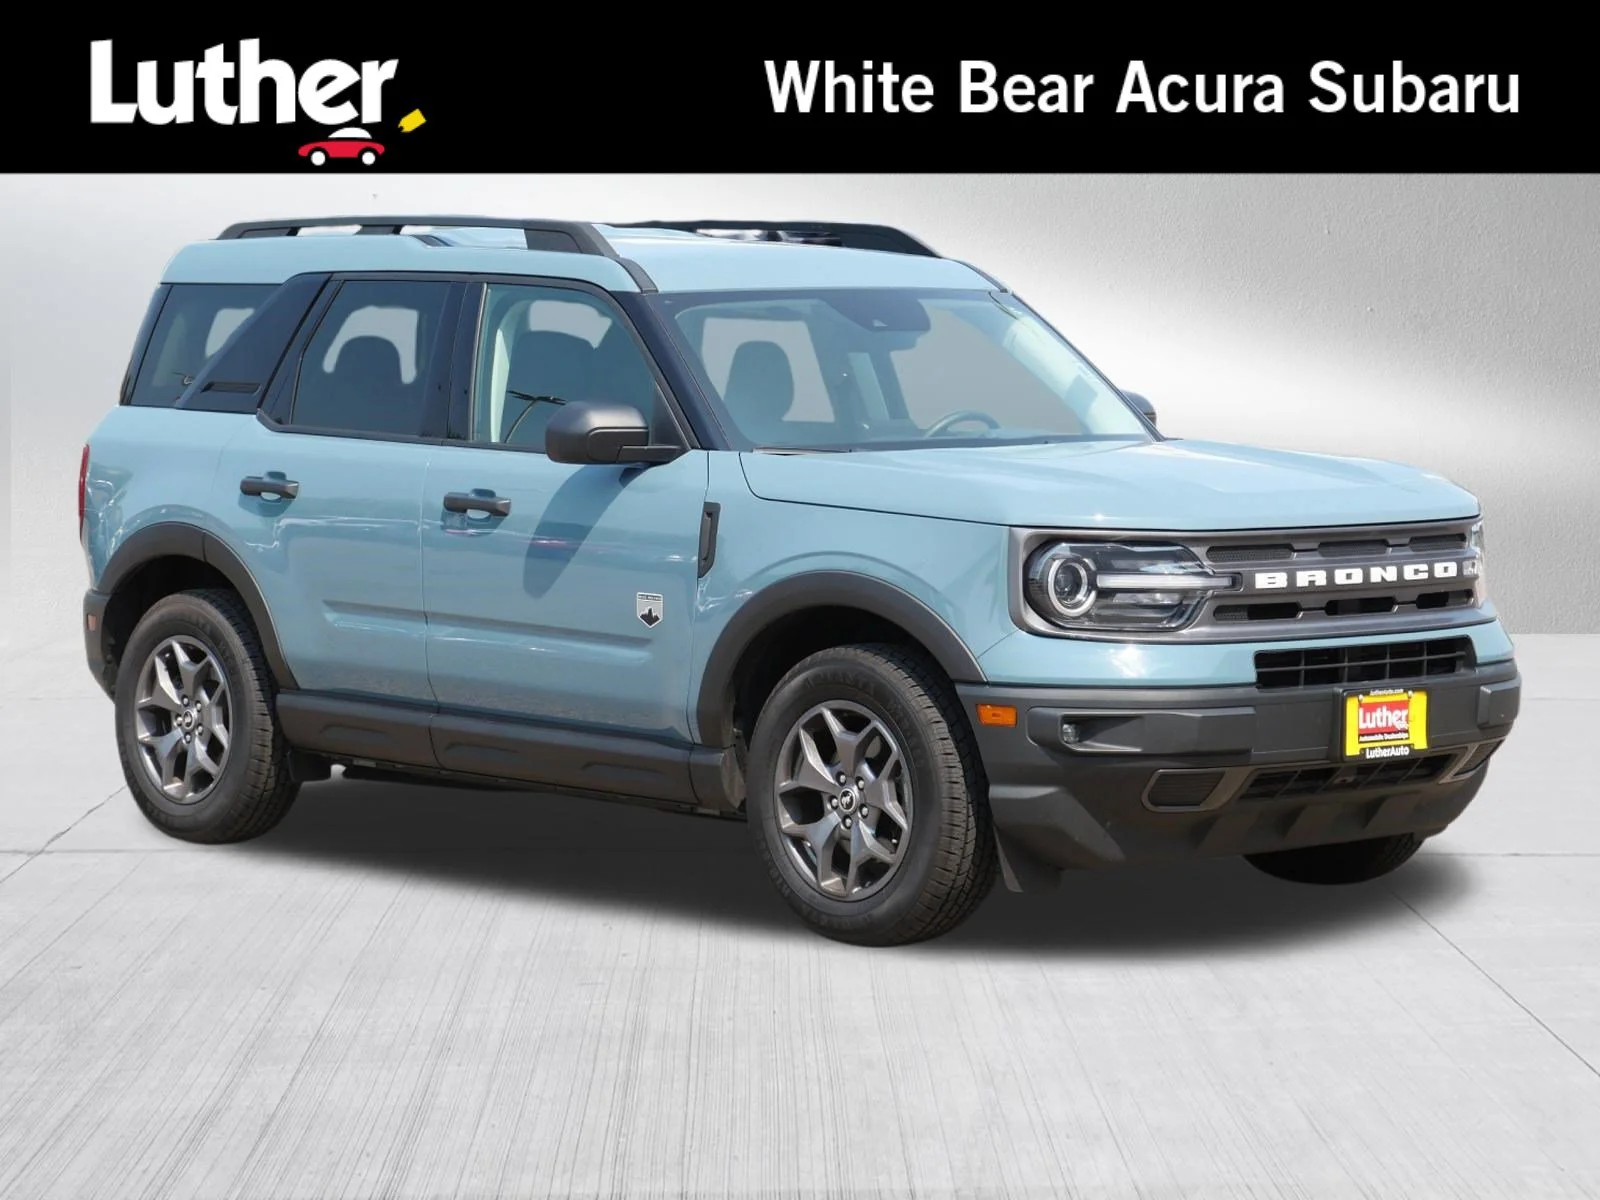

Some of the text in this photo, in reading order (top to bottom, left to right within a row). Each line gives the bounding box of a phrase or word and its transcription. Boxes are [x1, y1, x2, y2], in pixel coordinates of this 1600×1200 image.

[1255, 561, 1458, 589] BRONCO
[1358, 705, 1409, 729] Luther
[1366, 745, 1410, 759] LutherAuto
